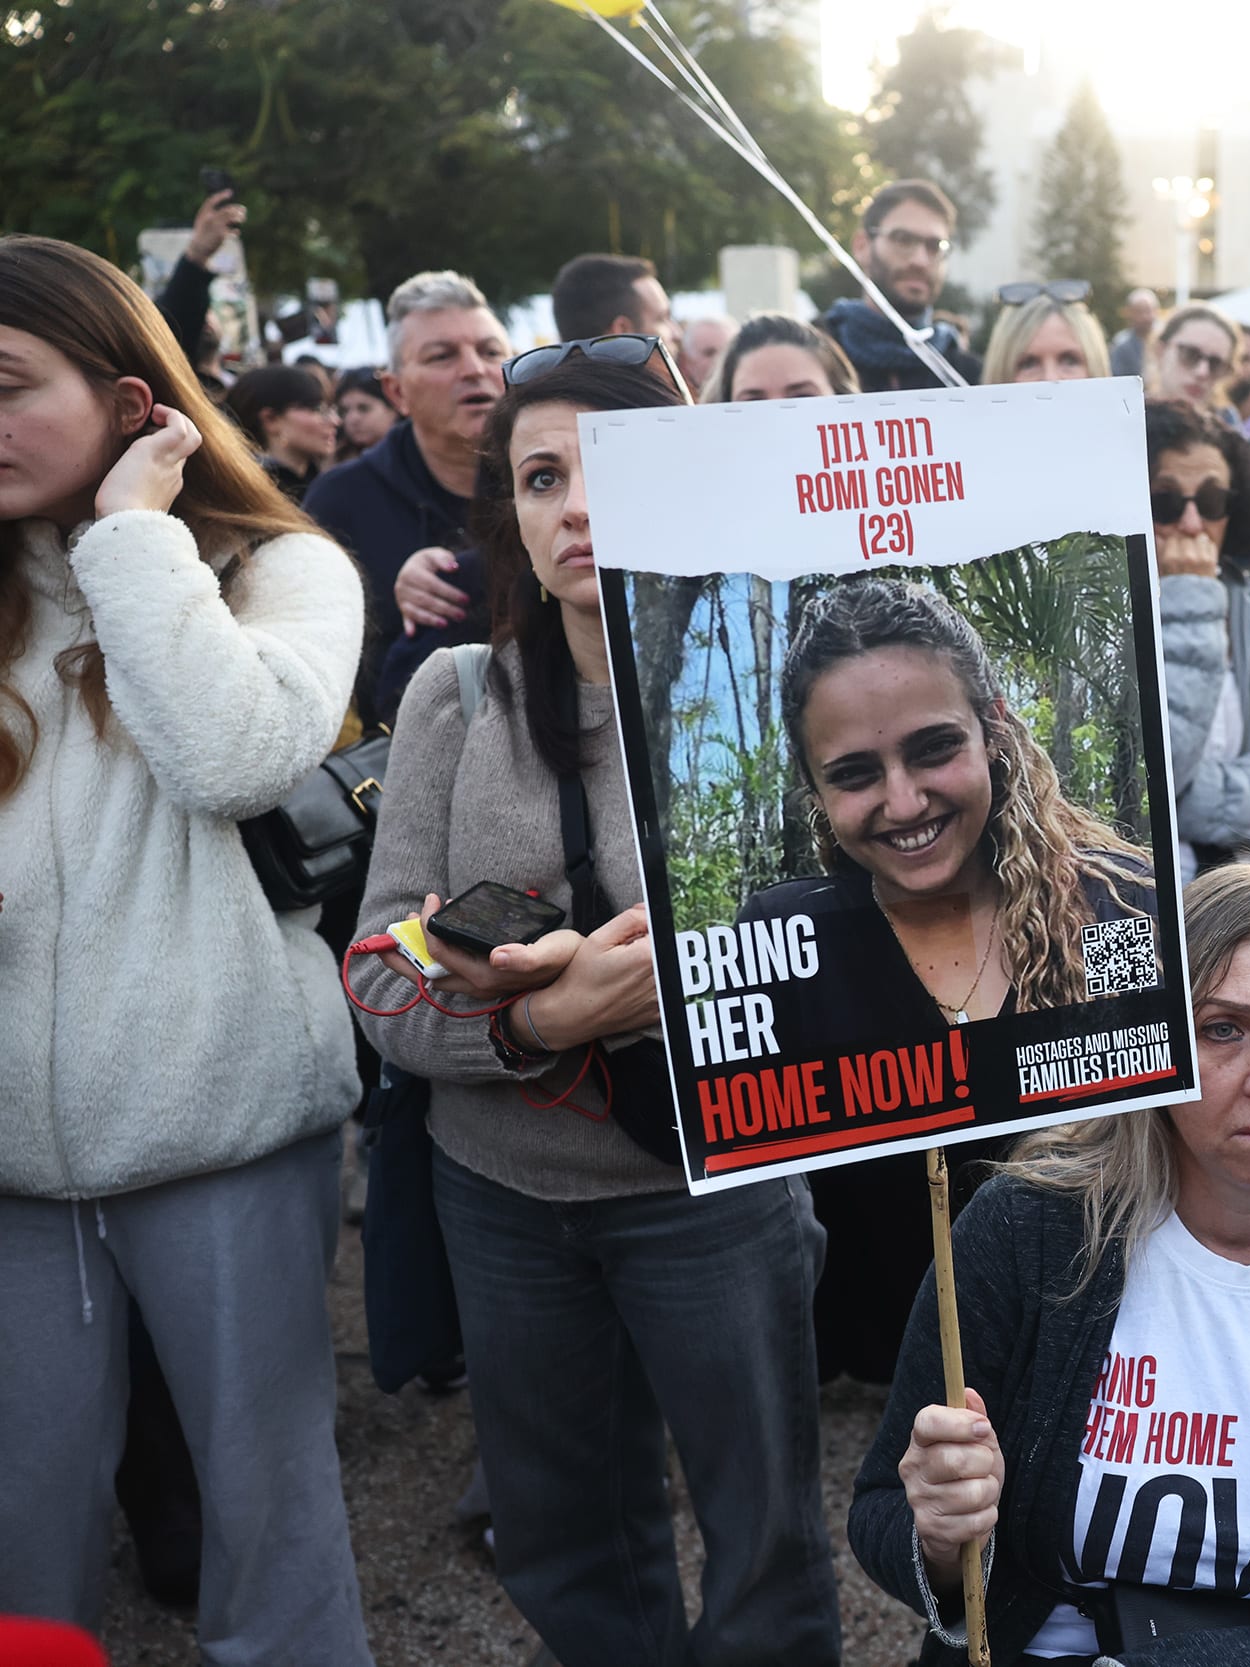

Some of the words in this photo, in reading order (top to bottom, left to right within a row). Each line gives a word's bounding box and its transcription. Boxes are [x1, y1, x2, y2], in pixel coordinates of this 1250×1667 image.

[816, 421, 869, 470] גונן
[874, 417, 934, 459] רומי
[795, 468, 869, 514] ROMI
[875, 461, 965, 507] GONEN
[858, 509, 914, 560] (23)
[675, 913, 820, 997] BRING
[684, 992, 782, 1068] HER
[1015, 1036, 1083, 1067] HOSTAGES
[1084, 1032, 1111, 1056] AND
[1112, 1021, 1170, 1050] MISSING
[697, 1060, 832, 1144] HOME
[838, 1029, 971, 1118] NOW!
[1018, 1054, 1104, 1097] FAMILIES
[1105, 1041, 1173, 1081] FORUM
[1091, 1351, 1157, 1409] RING
[1083, 1403, 1139, 1465] HEM
[1143, 1410, 1239, 1467] HOME
